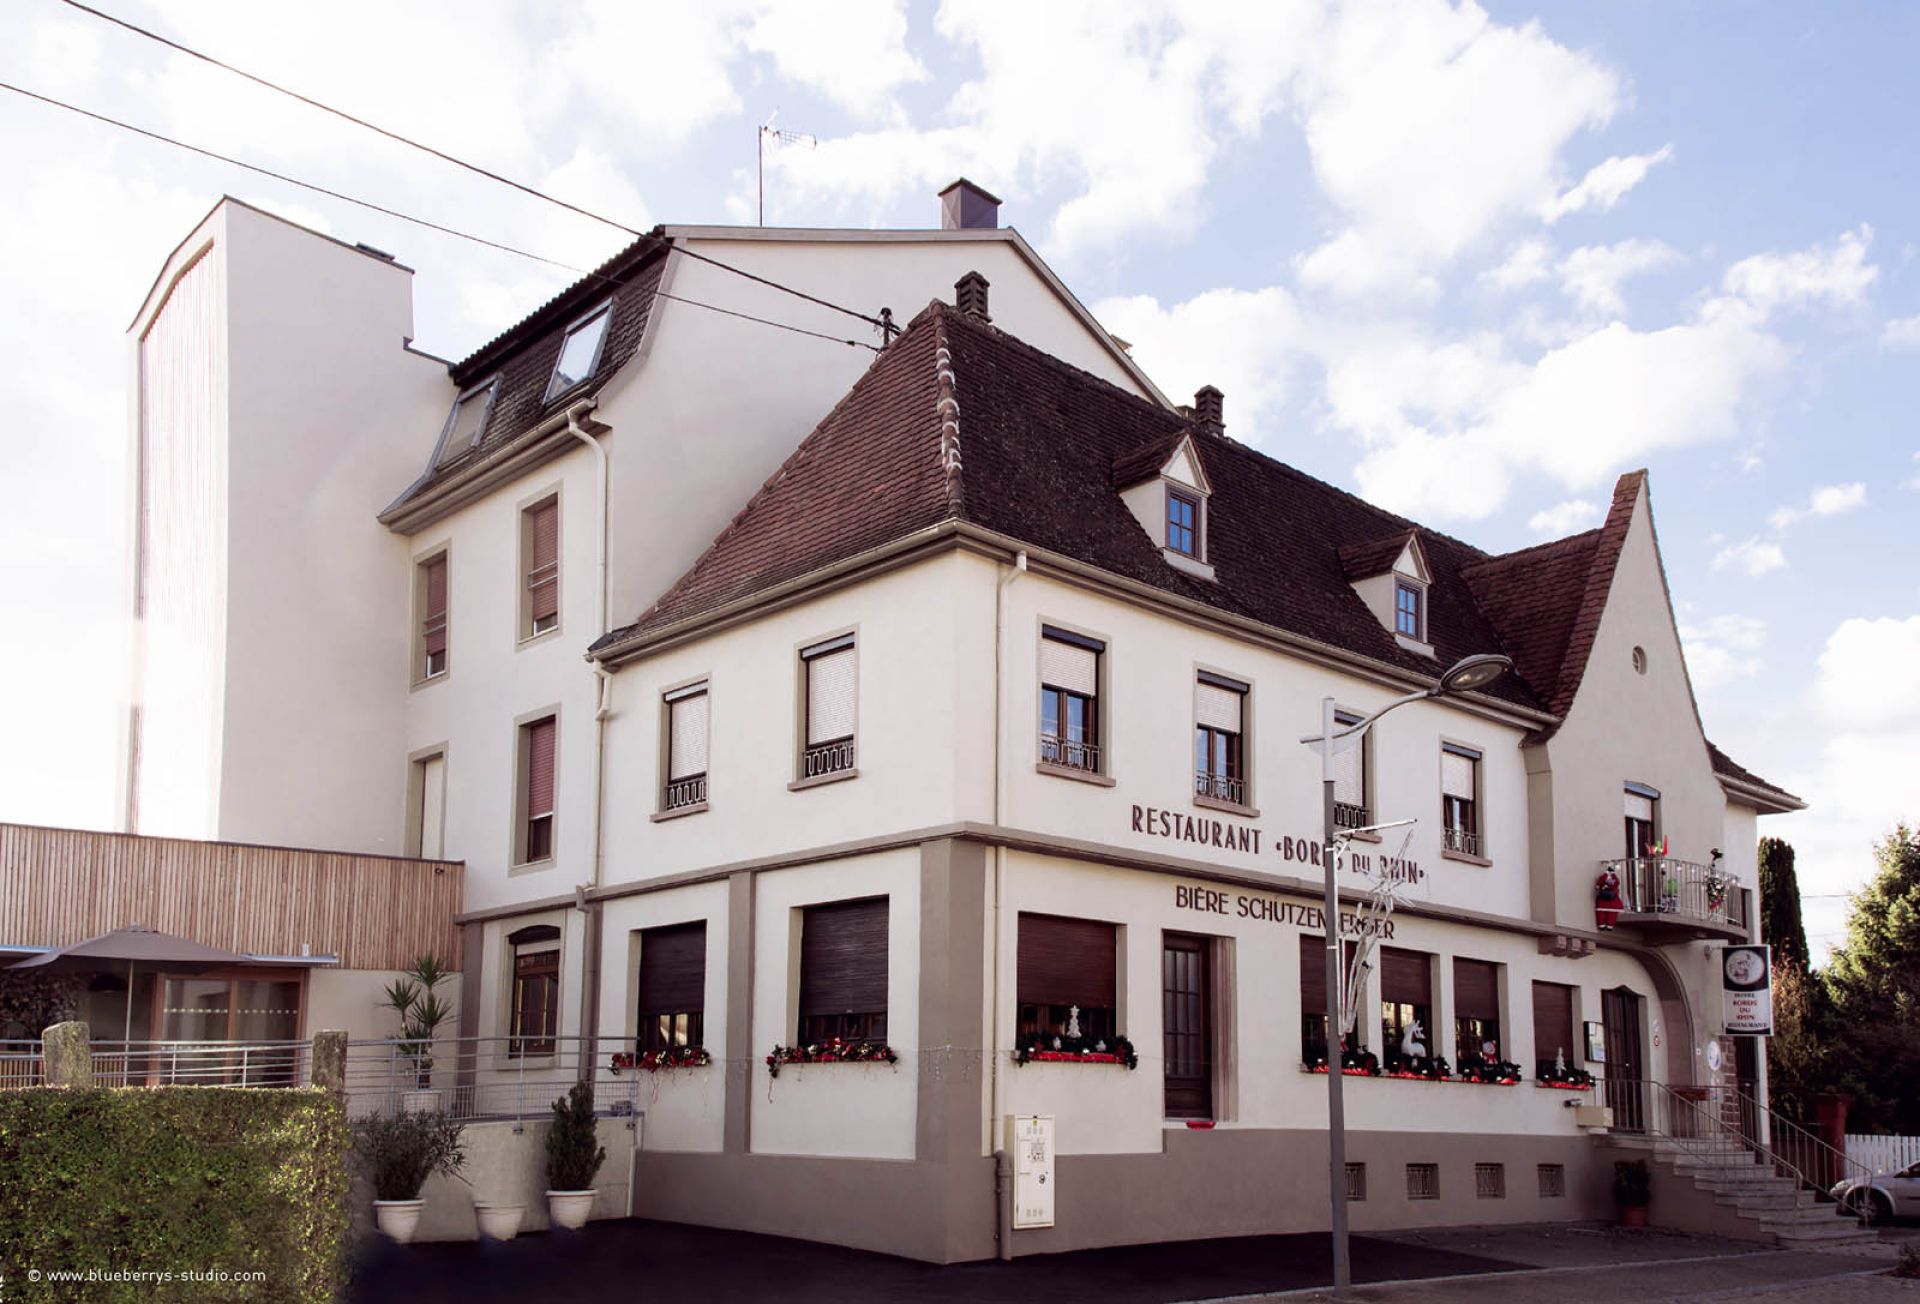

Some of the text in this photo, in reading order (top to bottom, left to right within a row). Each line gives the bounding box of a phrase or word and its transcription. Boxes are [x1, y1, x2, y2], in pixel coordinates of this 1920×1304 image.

[1131, 804, 1262, 855] RESTAURANT
[1282, 835, 1344, 871] BOR
[1351, 852, 1371, 876] DU
[1175, 885, 1395, 940] BIÈRE SCHUTZENERGER
